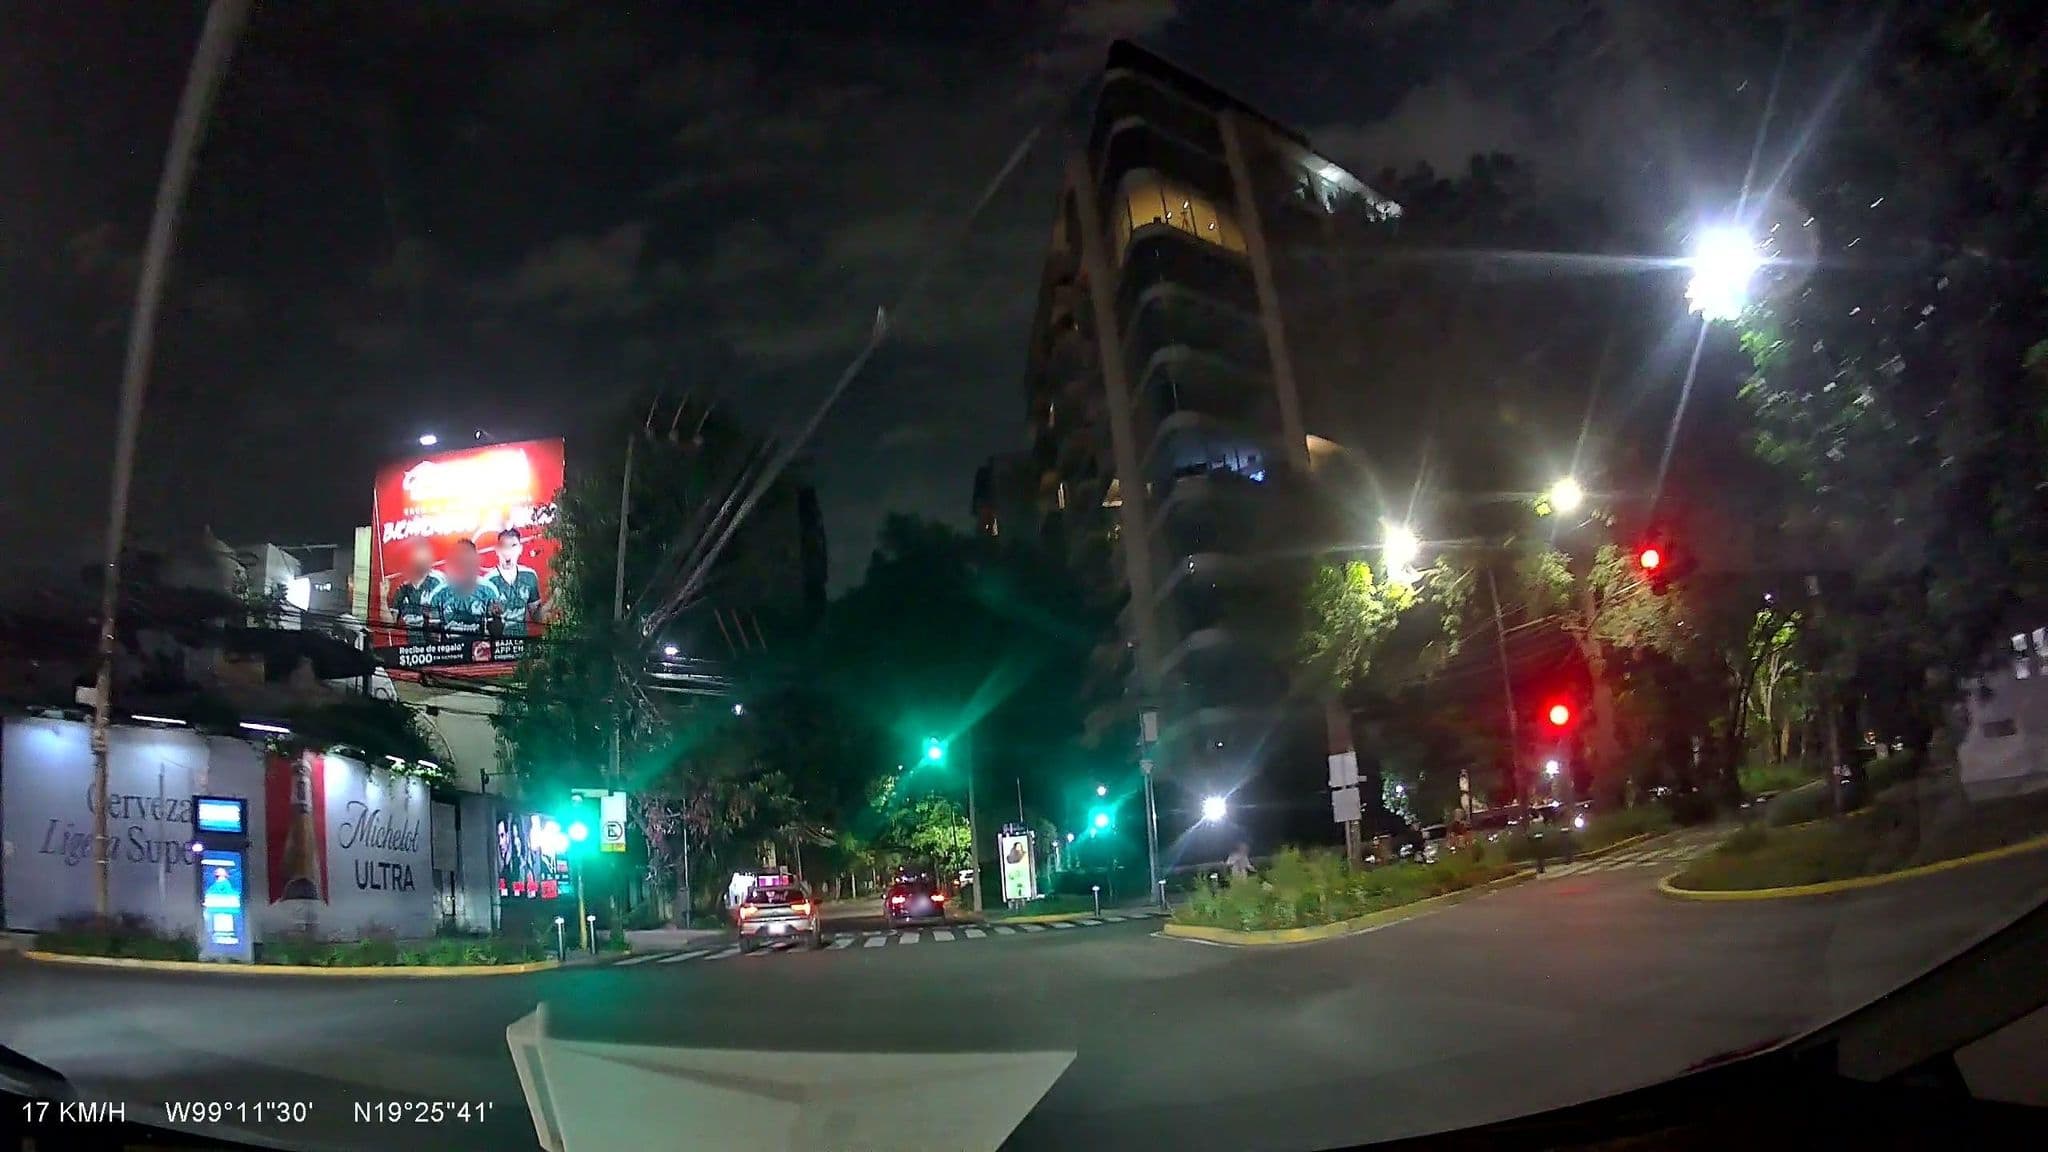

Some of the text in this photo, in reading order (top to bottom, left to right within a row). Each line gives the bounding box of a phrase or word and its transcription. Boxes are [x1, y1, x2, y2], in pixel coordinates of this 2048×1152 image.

[399, 645, 425, 655] Recibe
[426, 644, 436, 653] de
[399, 653, 433, 667] $1,000
[355, 859, 416, 891] ULTRA
